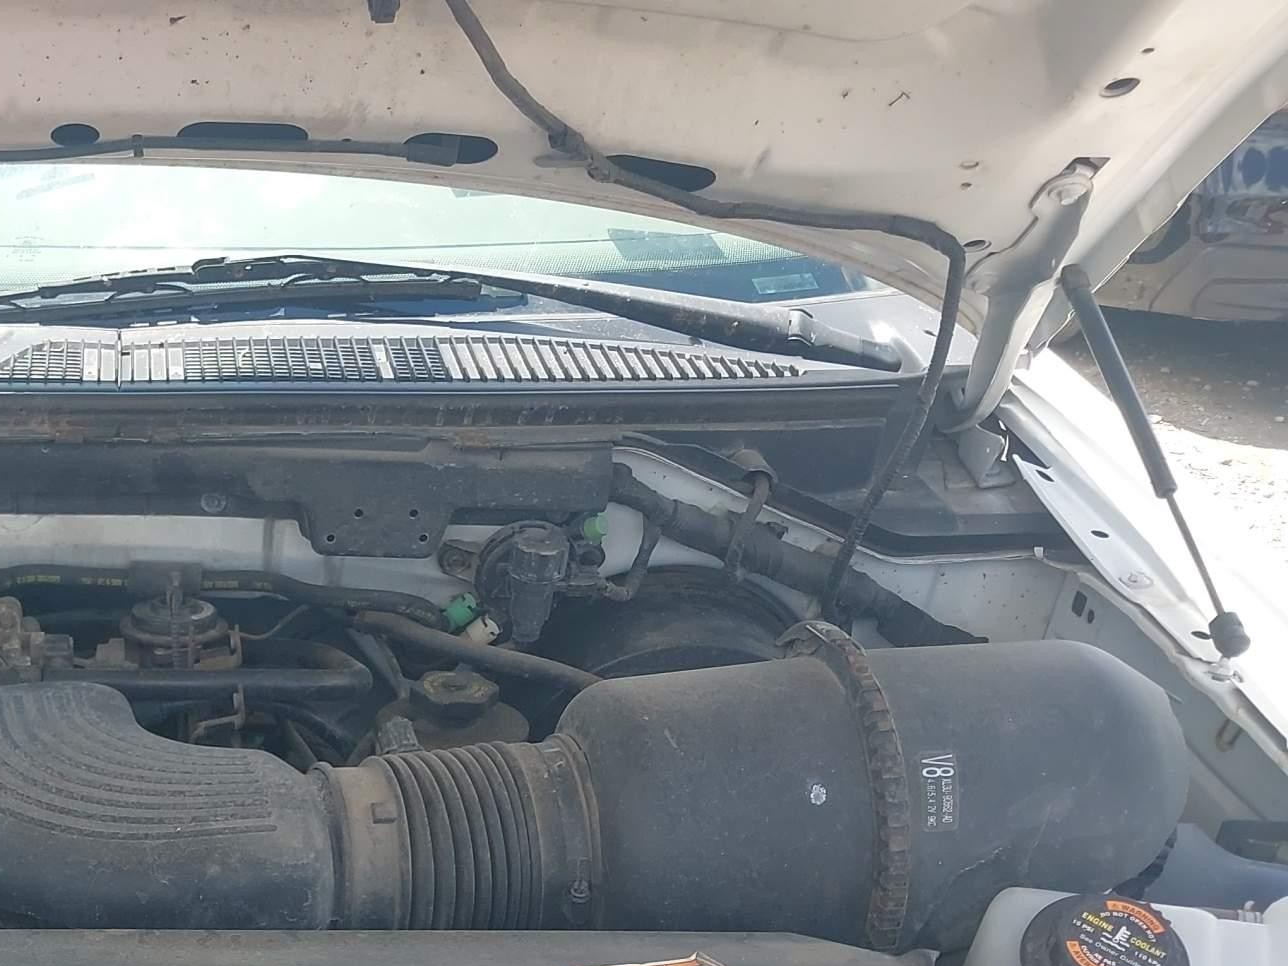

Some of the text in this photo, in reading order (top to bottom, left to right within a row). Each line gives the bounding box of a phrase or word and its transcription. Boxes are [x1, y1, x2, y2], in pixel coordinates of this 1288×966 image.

[921, 754, 956, 777] V8
[1081, 912, 1114, 932] ENGINE
[1112, 911, 1130, 919] NOT
[1120, 904, 1161, 932] WARNING
[1079, 933, 1094, 944] See
[1094, 941, 1119, 956] Owner
[1130, 937, 1167, 959] COOLANT
